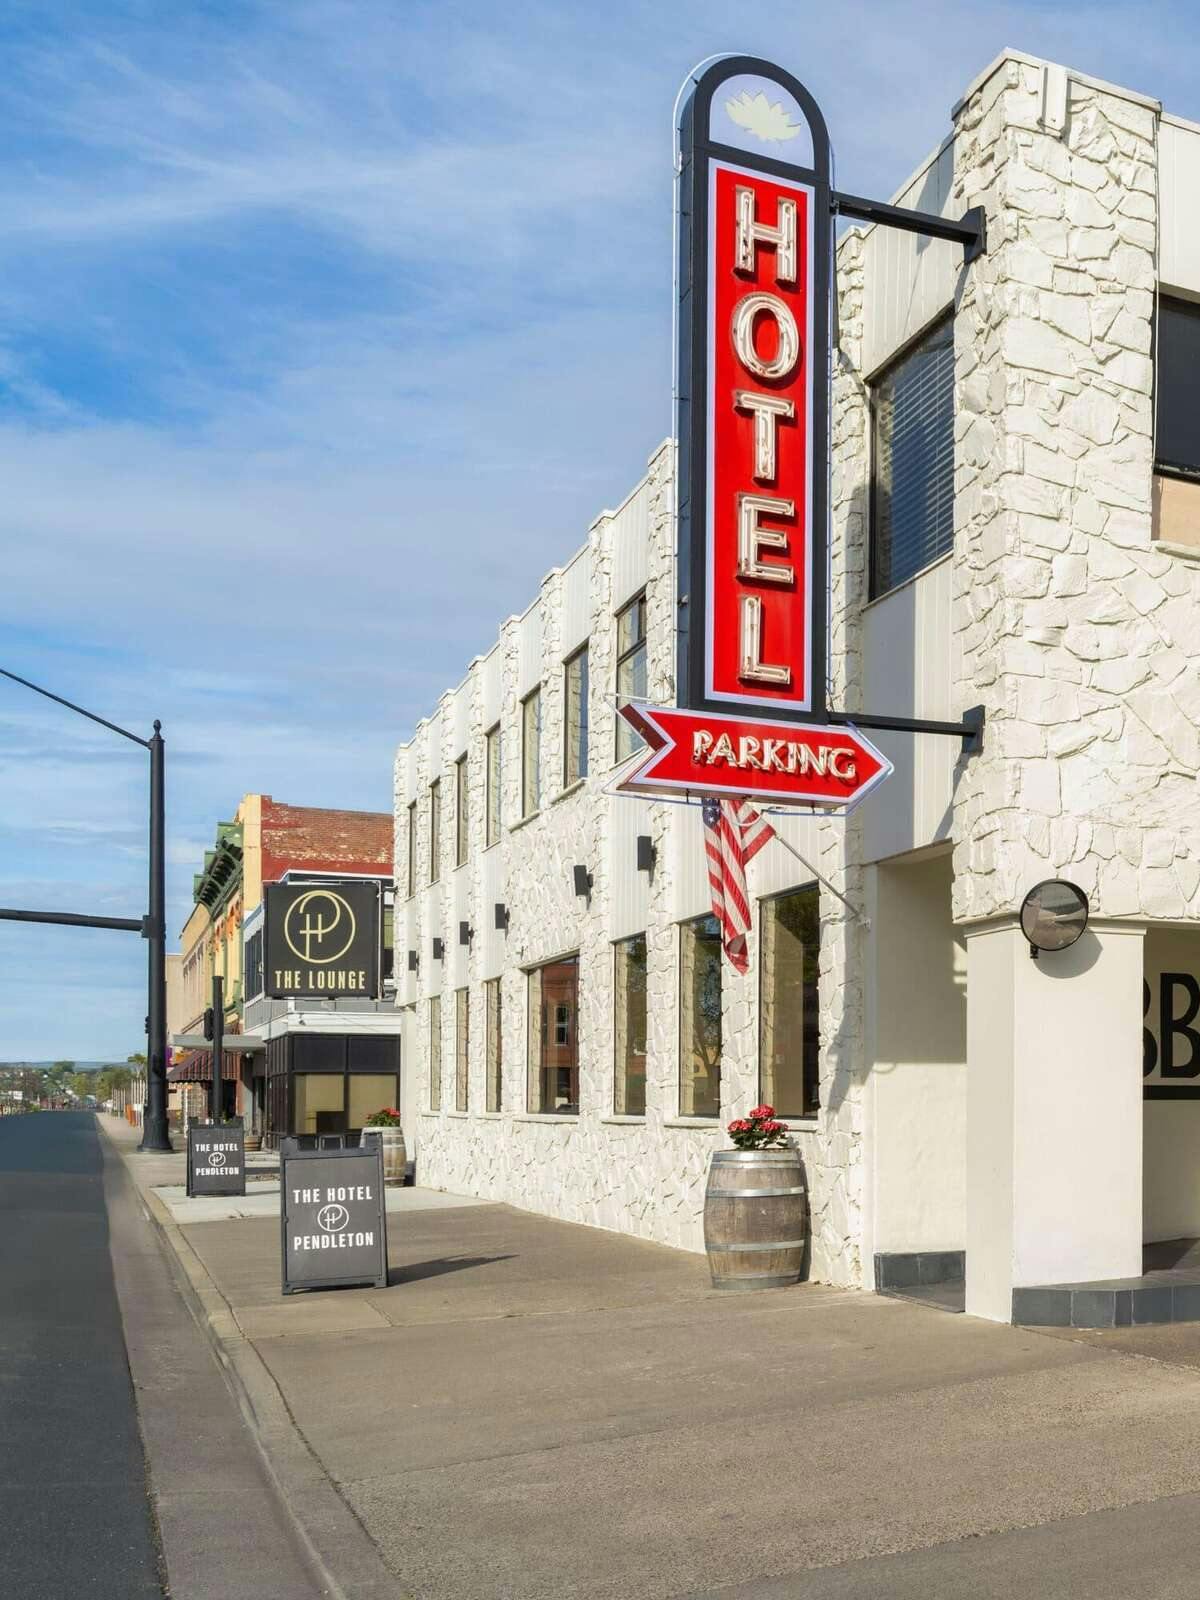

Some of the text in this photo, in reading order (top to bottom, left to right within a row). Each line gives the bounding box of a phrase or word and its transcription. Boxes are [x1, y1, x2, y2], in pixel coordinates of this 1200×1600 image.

[733, 184, 798, 686] HOTEL
[693, 729, 857, 779] PARKING
[274, 970, 366, 989] THE LOUNGE
[195, 1143, 239, 1152] THE HOTEL
[195, 1167, 240, 1176] PENDLETON
[293, 1185, 373, 1204] THE HOTEL
[293, 1232, 374, 1251] PENDLETON
